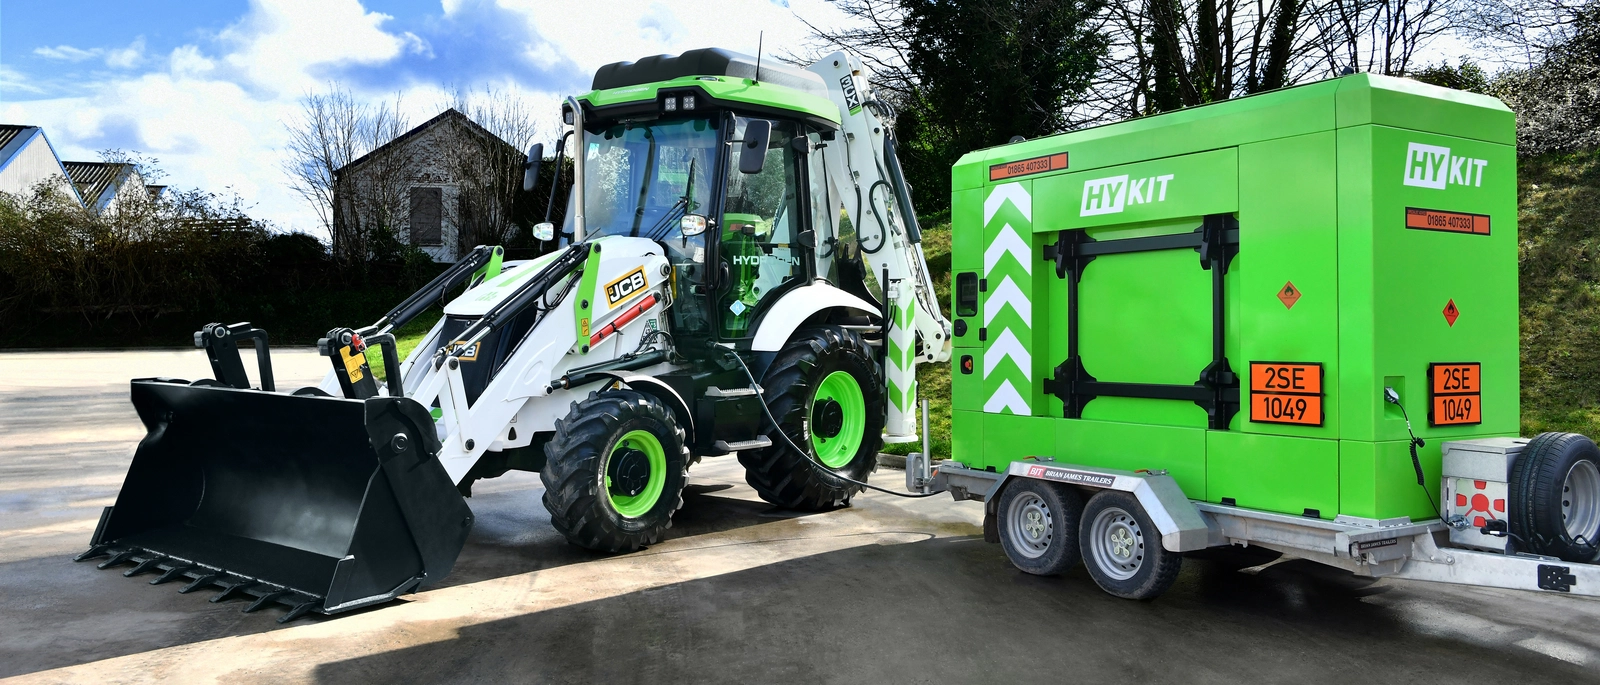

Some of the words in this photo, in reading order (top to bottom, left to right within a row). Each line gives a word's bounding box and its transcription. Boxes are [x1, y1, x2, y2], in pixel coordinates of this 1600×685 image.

[841, 75, 859, 107] 3CX
[1008, 163, 1025, 175] 01865
[1026, 159, 1048, 171] 407333
[1427, 214, 1447, 227] 01865
[1448, 217, 1471, 229] 407333
[610, 272, 645, 302] JCB
[1264, 367, 1306, 390] 2SE
[1443, 367, 1471, 390] 2SE
[1263, 396, 1307, 421] 1049
[1442, 398, 1472, 421] 1049
[1045, 470, 1062, 478] BRIAN
[1063, 472, 1082, 481] JAMES
[1083, 475, 1112, 484] TRAILERS
